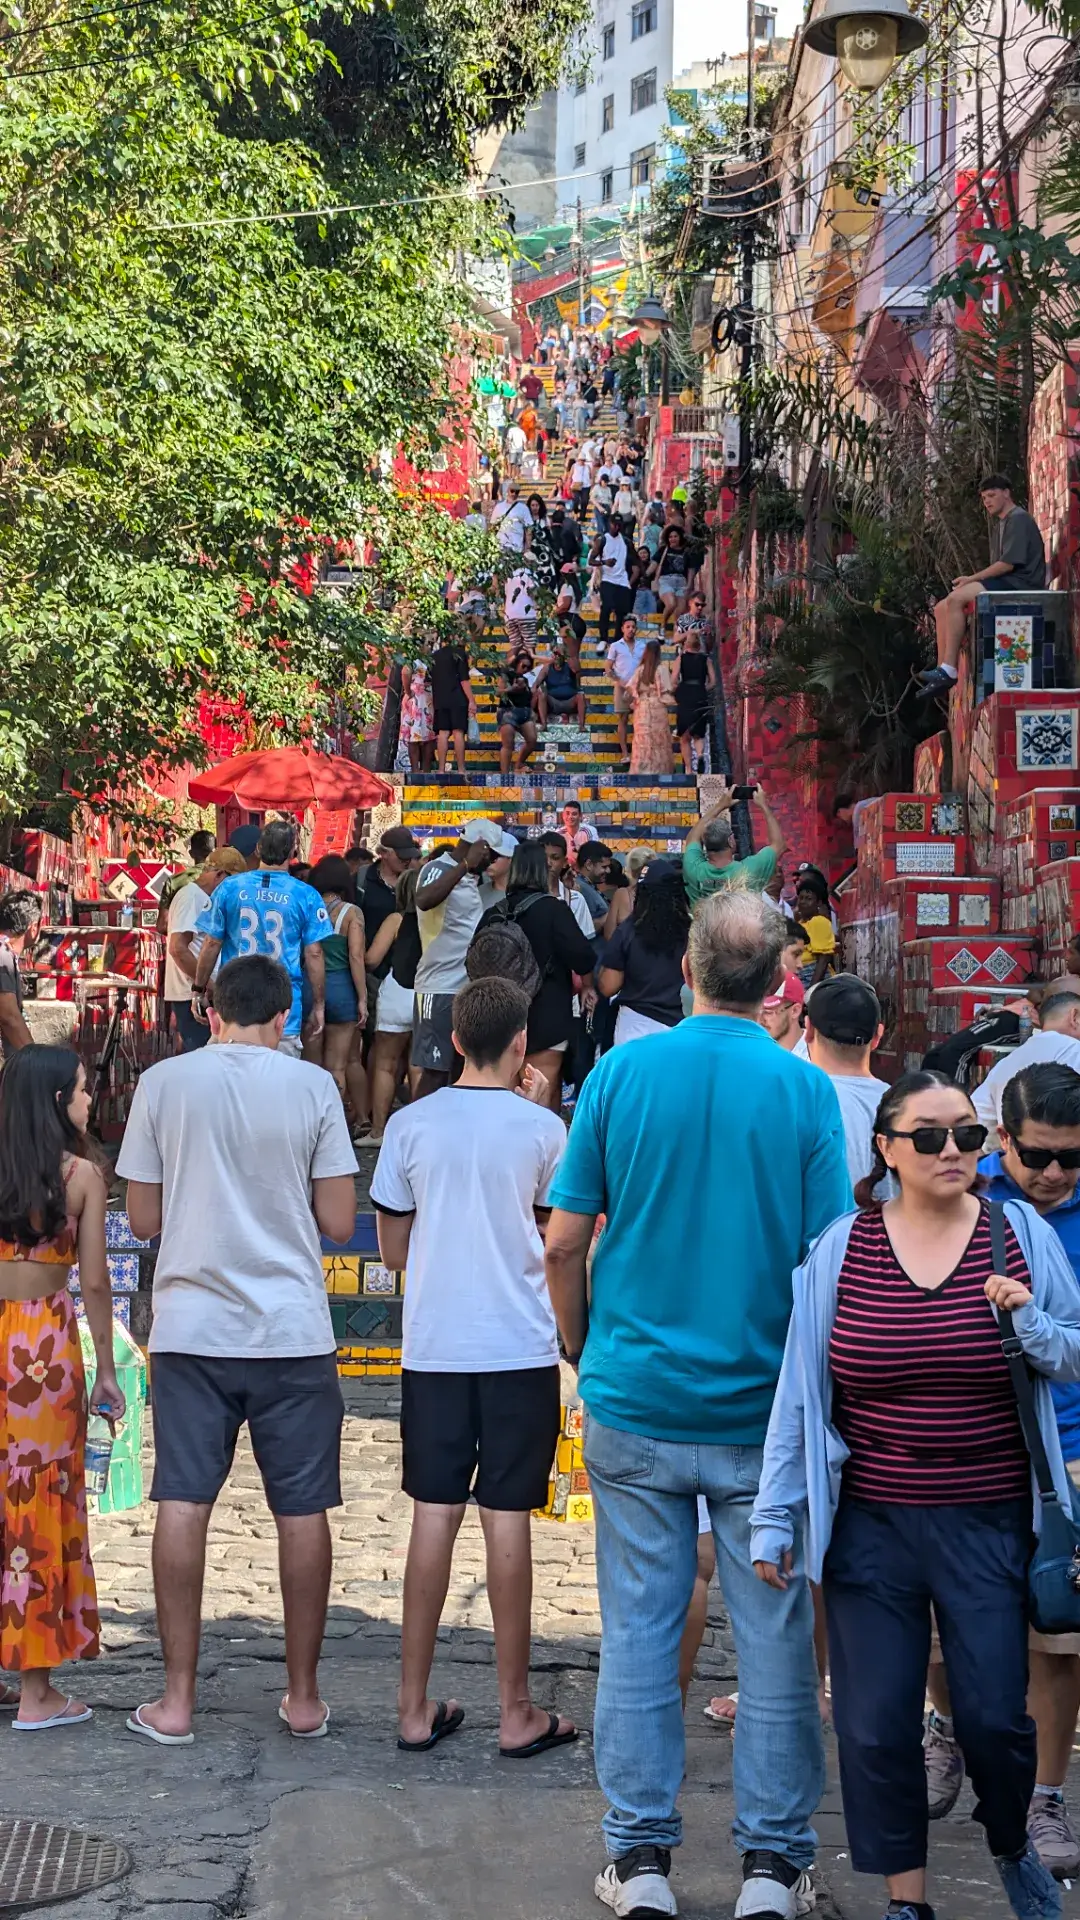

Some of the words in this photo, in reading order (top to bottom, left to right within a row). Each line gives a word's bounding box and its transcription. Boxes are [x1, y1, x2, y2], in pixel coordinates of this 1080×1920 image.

[239, 889, 252, 901] G.
[256, 890, 289, 904] JESUS
[239, 906, 283, 960] 33
